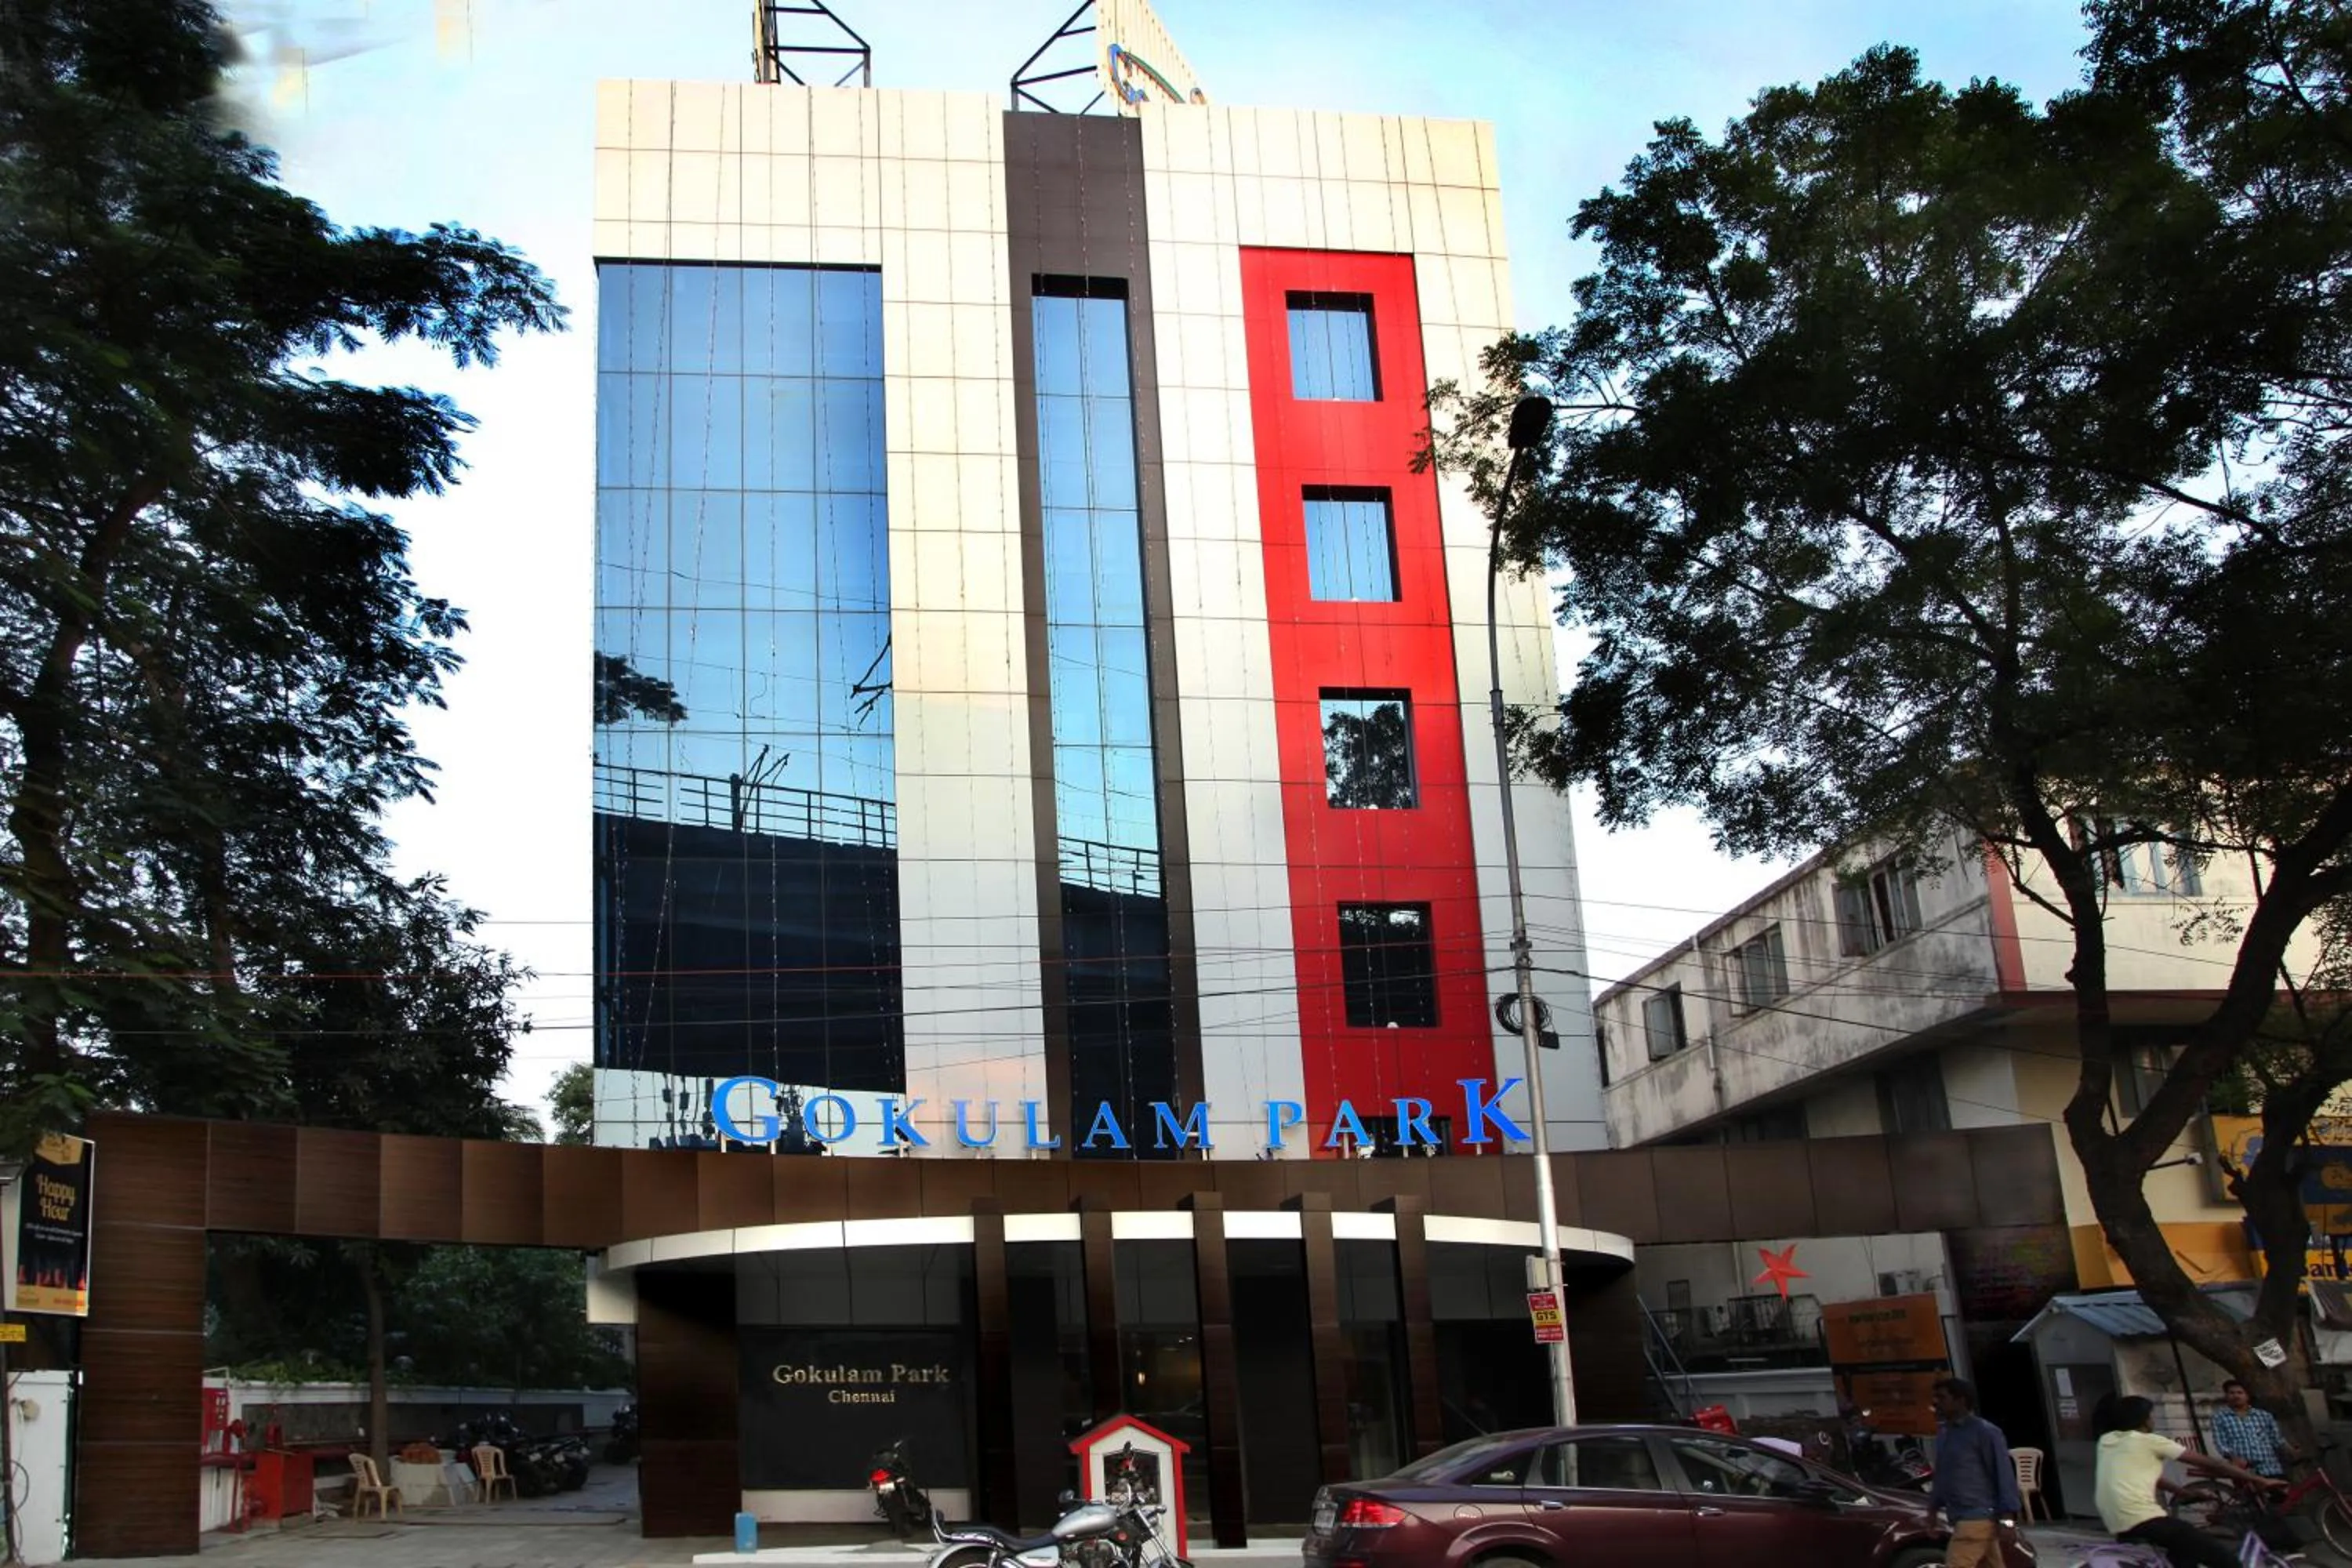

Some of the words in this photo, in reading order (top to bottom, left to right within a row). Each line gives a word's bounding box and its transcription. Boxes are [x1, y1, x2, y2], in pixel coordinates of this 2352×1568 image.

[711, 1076, 1212, 1149] GOKULAM
[1263, 1078, 1531, 1149] PARK
[36, 1174, 75, 1207] Happy
[40, 1196, 71, 1221] Hour
[772, 1364, 883, 1384] Gokulam
[891, 1363, 950, 1383] Park
[828, 1390, 895, 1403] Chennai
